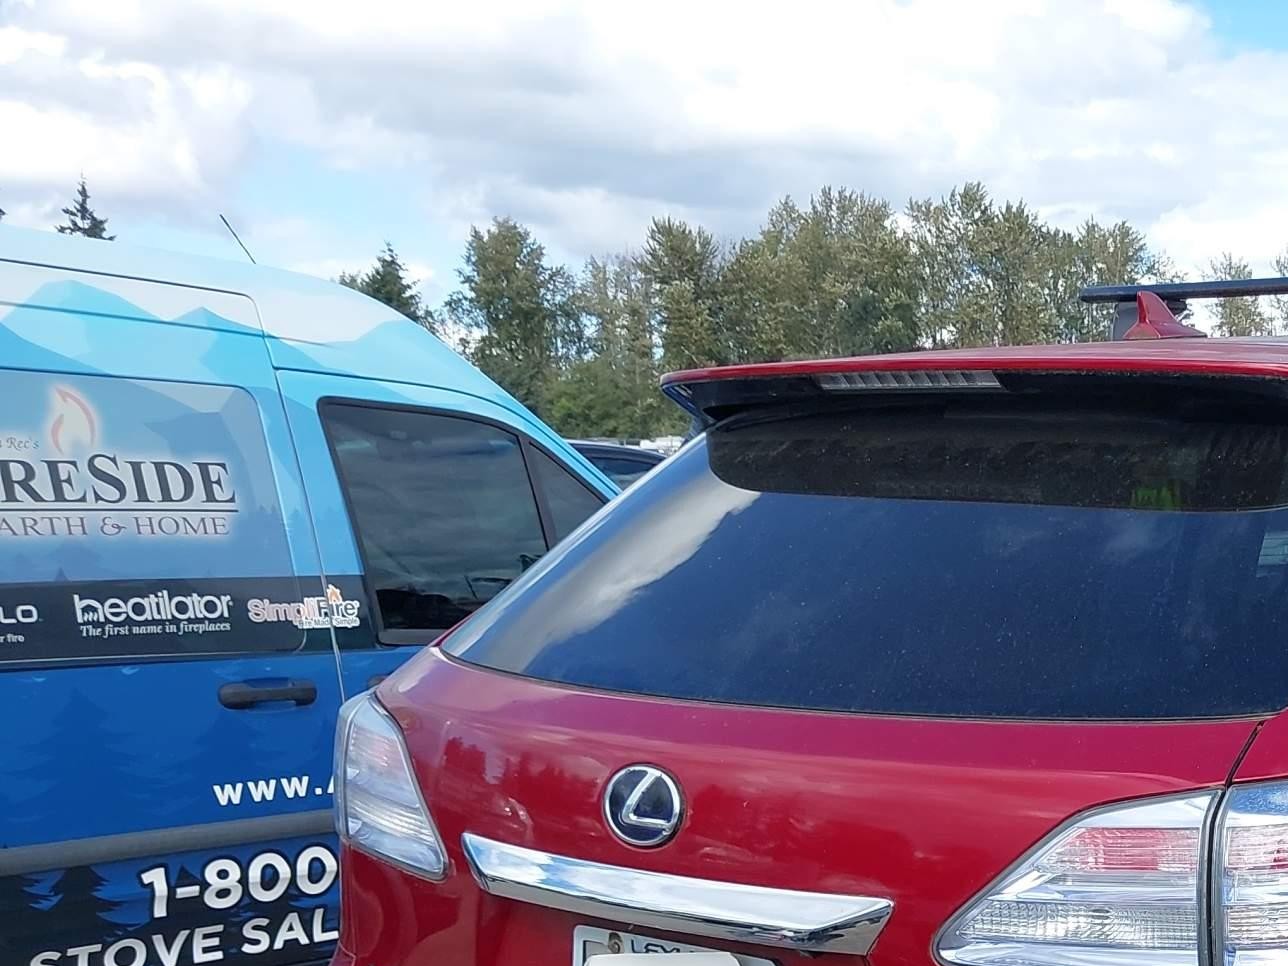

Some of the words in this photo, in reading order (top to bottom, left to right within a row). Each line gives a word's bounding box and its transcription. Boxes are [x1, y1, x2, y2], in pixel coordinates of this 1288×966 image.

[100, 516, 127, 536] &
[133, 516, 230, 536] HOME
[73, 590, 231, 623] heatilator
[80, 625, 101, 637] The
[102, 622, 129, 638] first
[132, 624, 163, 635] name
[165, 622, 177, 633] in
[178, 620, 232, 636] fireplaces
[141, 846, 338, 918] 1-800
[241, 908, 339, 954] SAL
